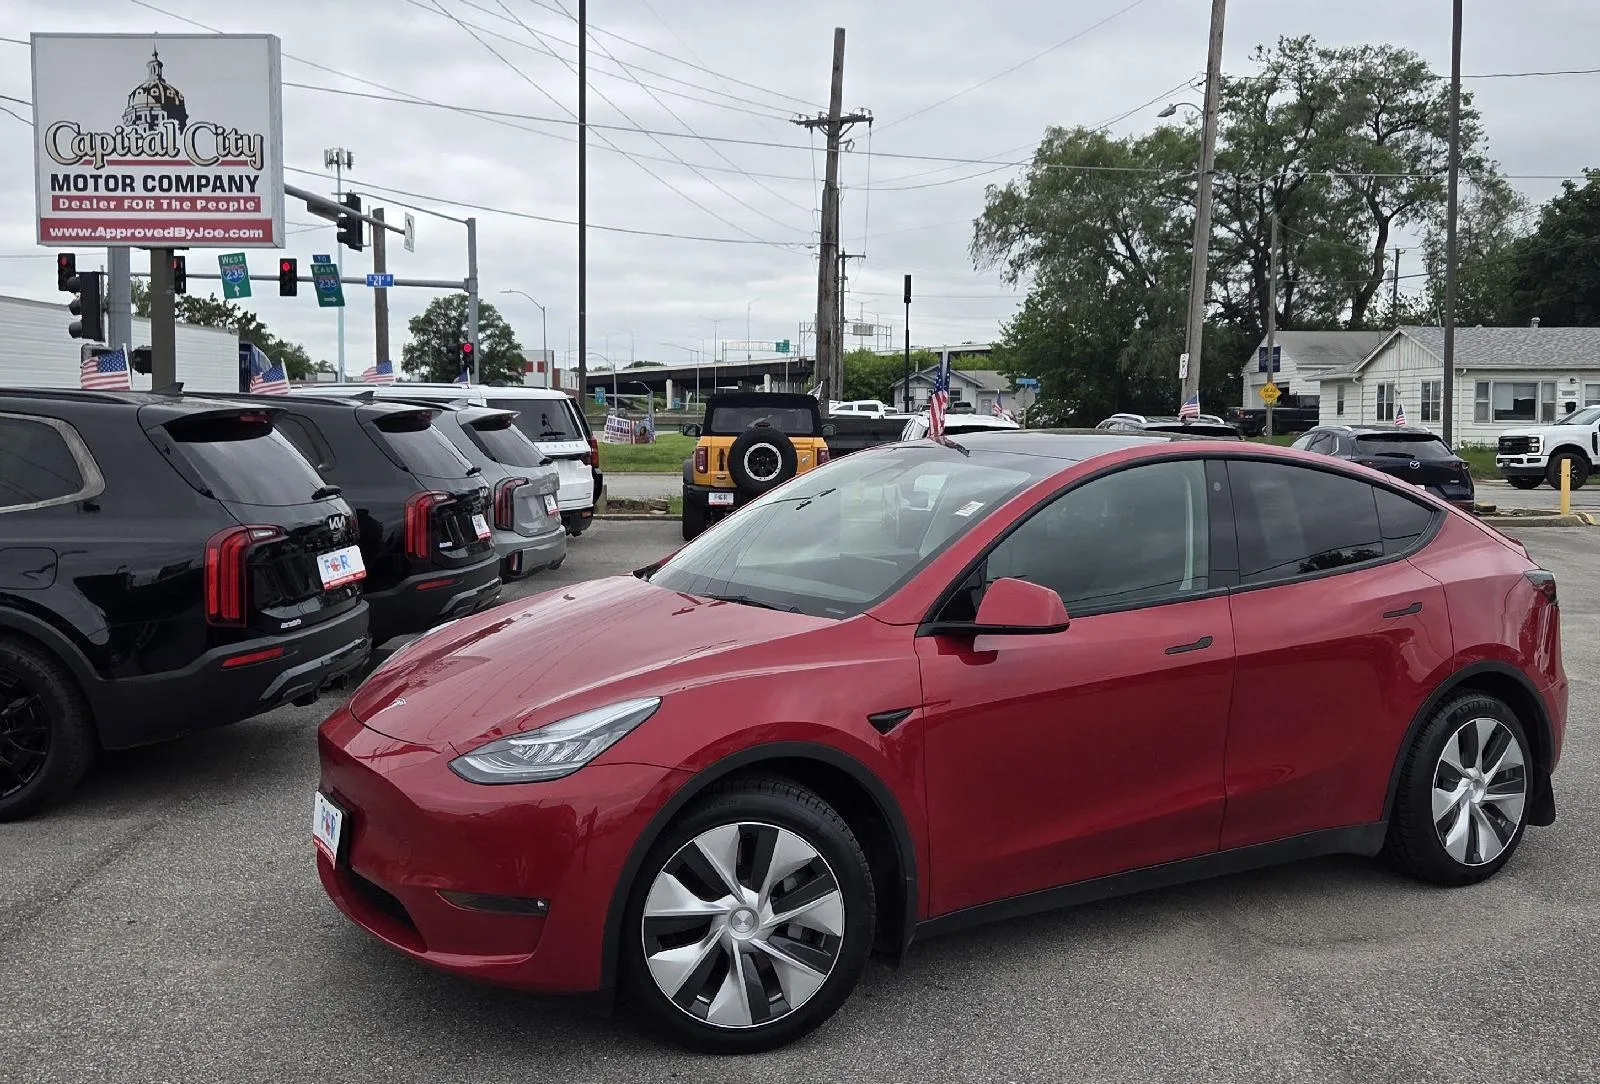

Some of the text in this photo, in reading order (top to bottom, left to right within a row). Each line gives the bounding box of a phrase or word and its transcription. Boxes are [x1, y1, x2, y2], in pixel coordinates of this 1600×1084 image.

[45, 120, 264, 170] Capital City
[50, 173, 260, 193] MOTOR COMPANY
[59, 198, 256, 212] Dealer FOR The People
[49, 226, 264, 240] www.ApprovedByJoe.com
[226, 269, 245, 279] 235
[319, 279, 337, 288] 235
